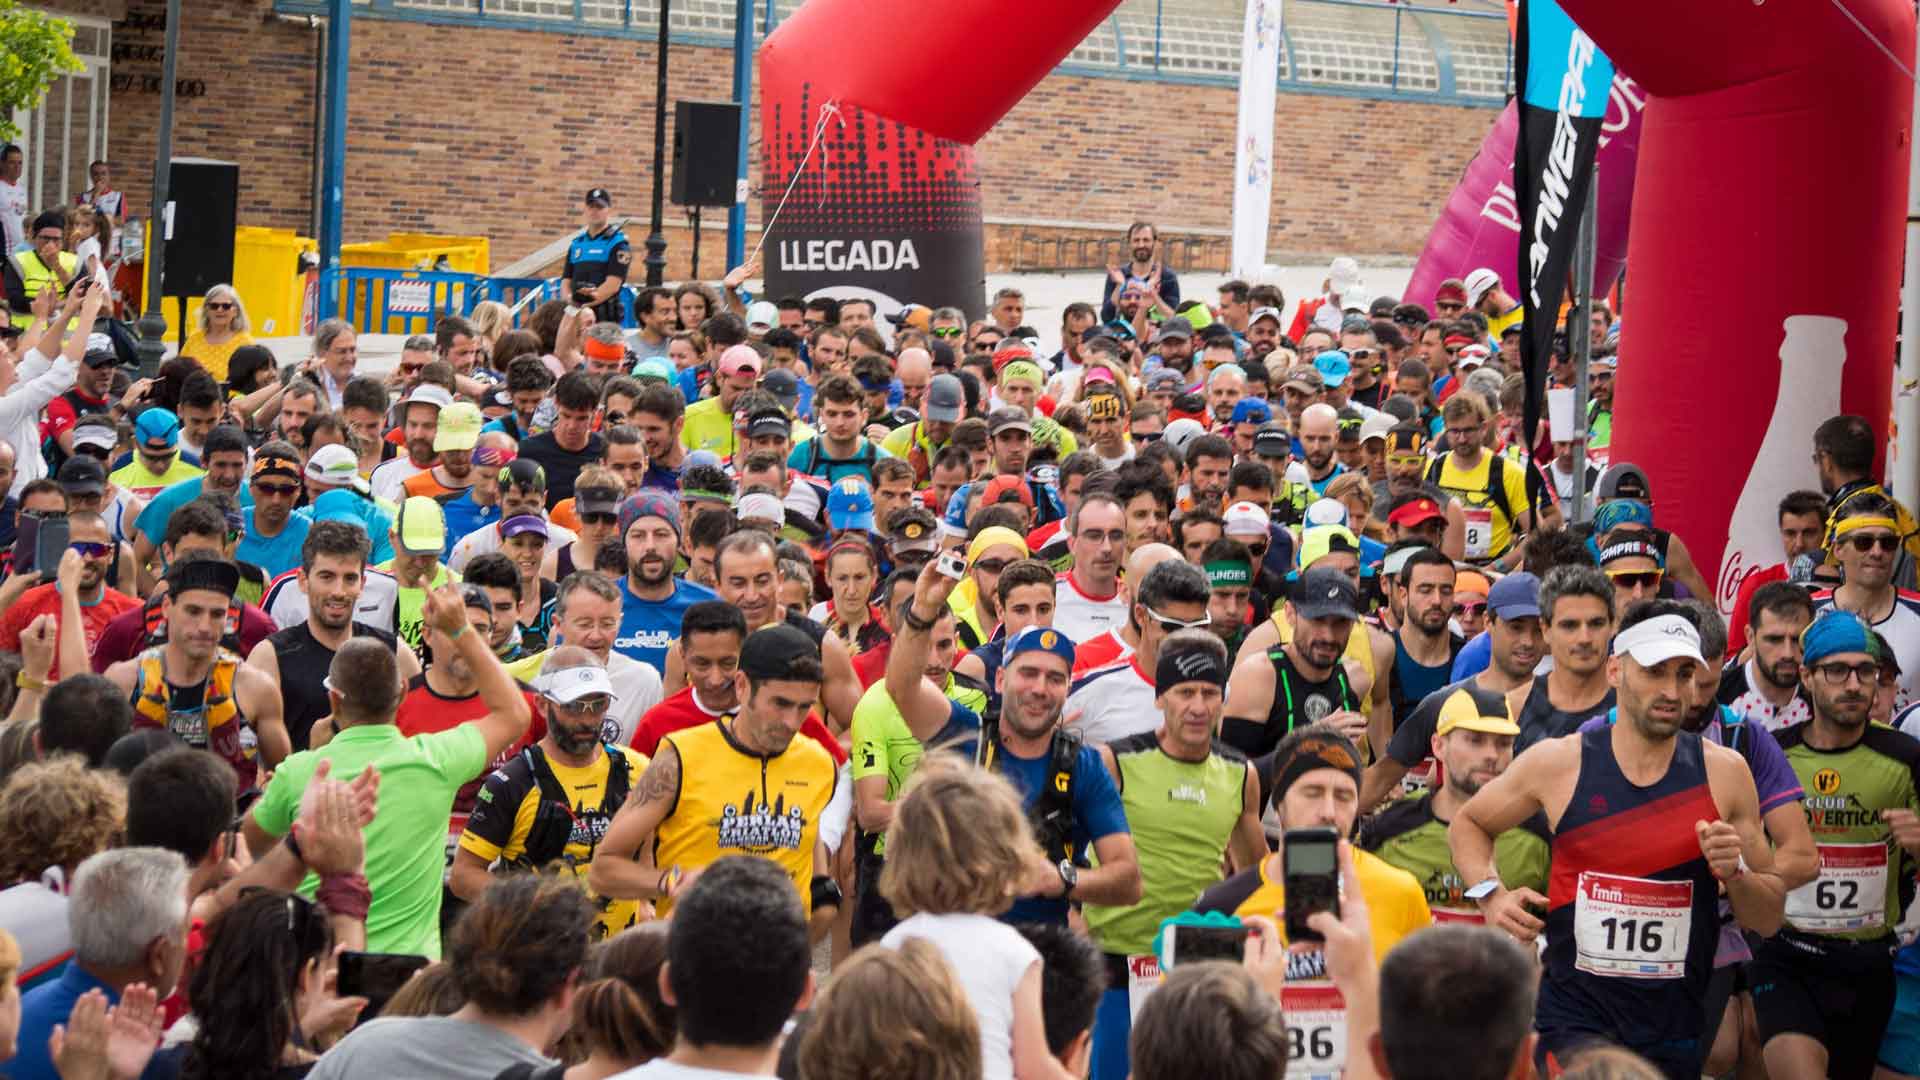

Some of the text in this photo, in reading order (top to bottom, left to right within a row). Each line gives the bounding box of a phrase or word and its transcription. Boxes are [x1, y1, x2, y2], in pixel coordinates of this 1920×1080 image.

[780, 239, 920, 271] LLEGADA
[1467, 528, 1478, 545] 8
[1803, 809, 1886, 827] VERTICA
[1592, 881, 1623, 903] fmm
[1816, 880, 1859, 911] 62
[1600, 917, 1664, 953] 116
